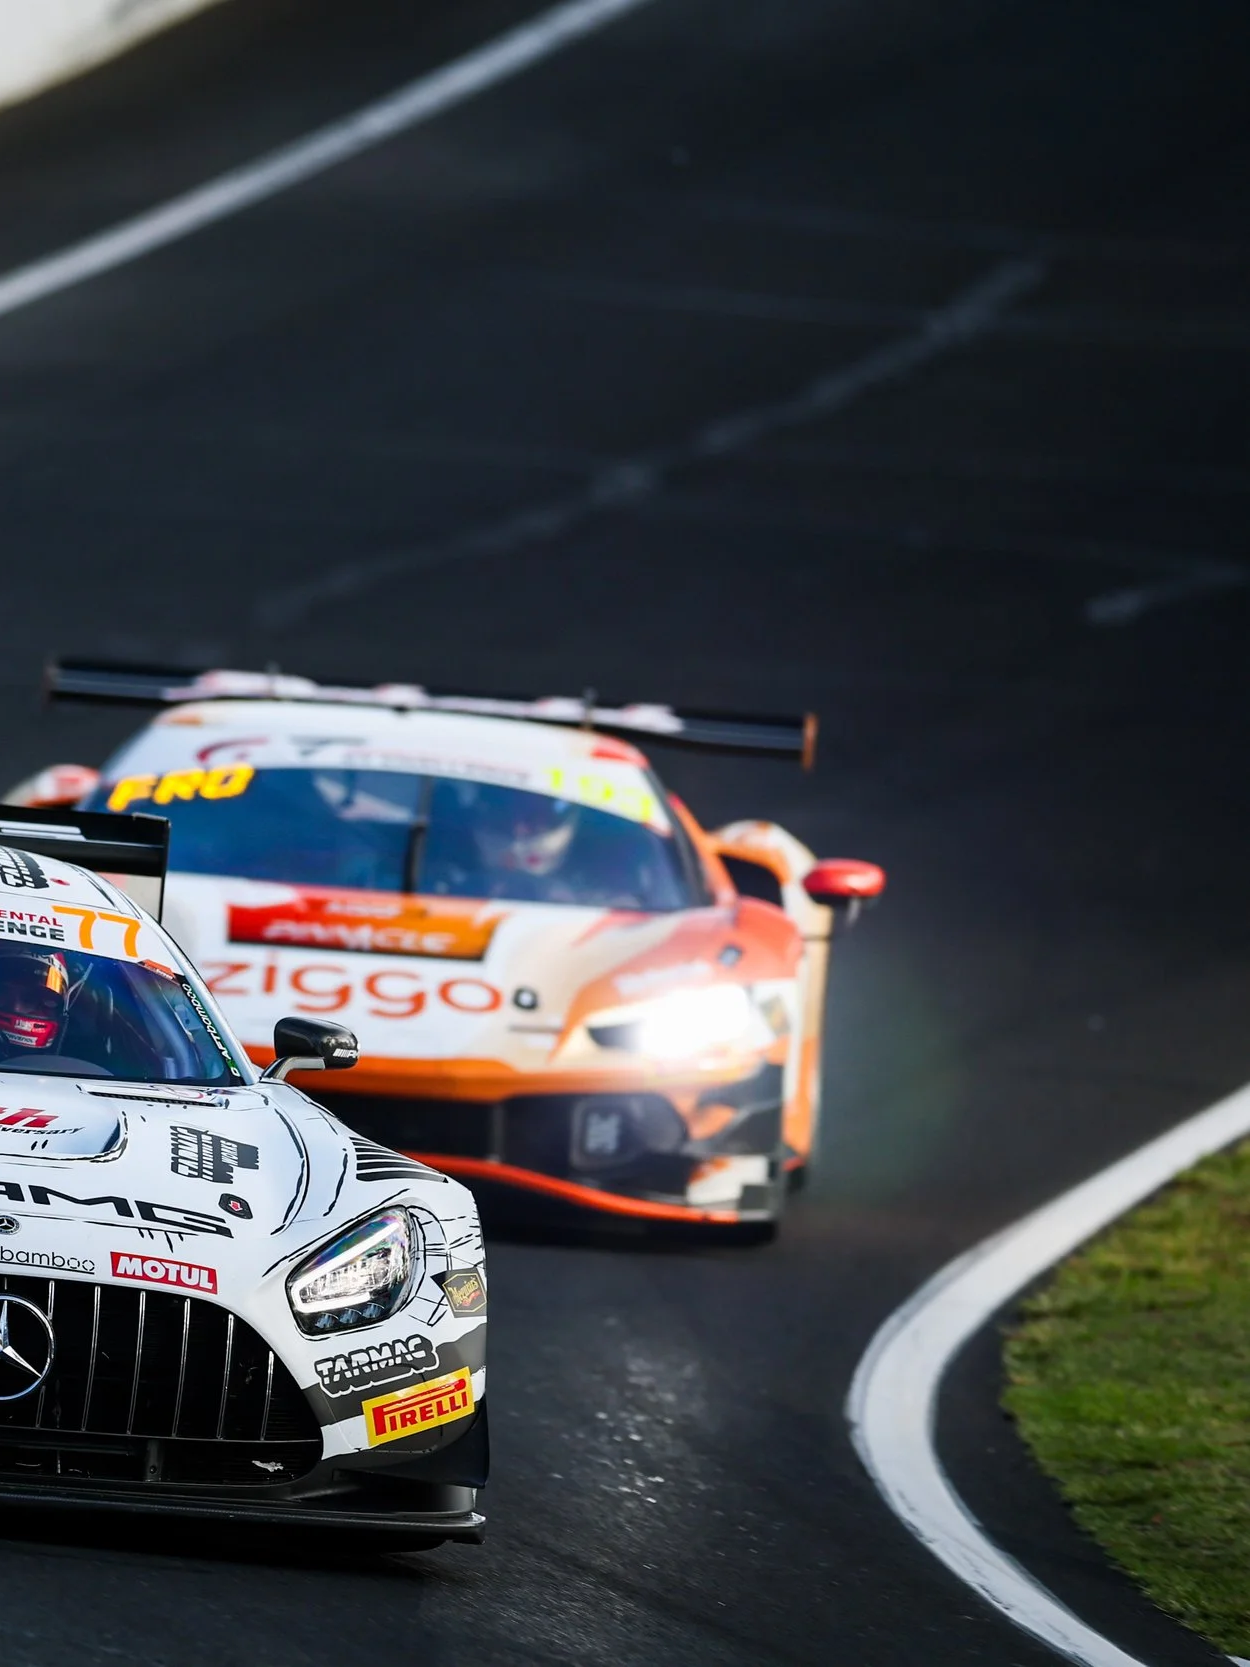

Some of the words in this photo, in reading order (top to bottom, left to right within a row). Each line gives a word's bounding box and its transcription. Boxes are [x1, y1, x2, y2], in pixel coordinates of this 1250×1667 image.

[108, 762, 255, 812] FRO
[52, 905, 142, 958] 77
[201, 950, 503, 1018] ziggo
[116, 1255, 214, 1290] MOTUL
[317, 1336, 427, 1385] TARMAC
[372, 1378, 469, 1437] PIRELLI
